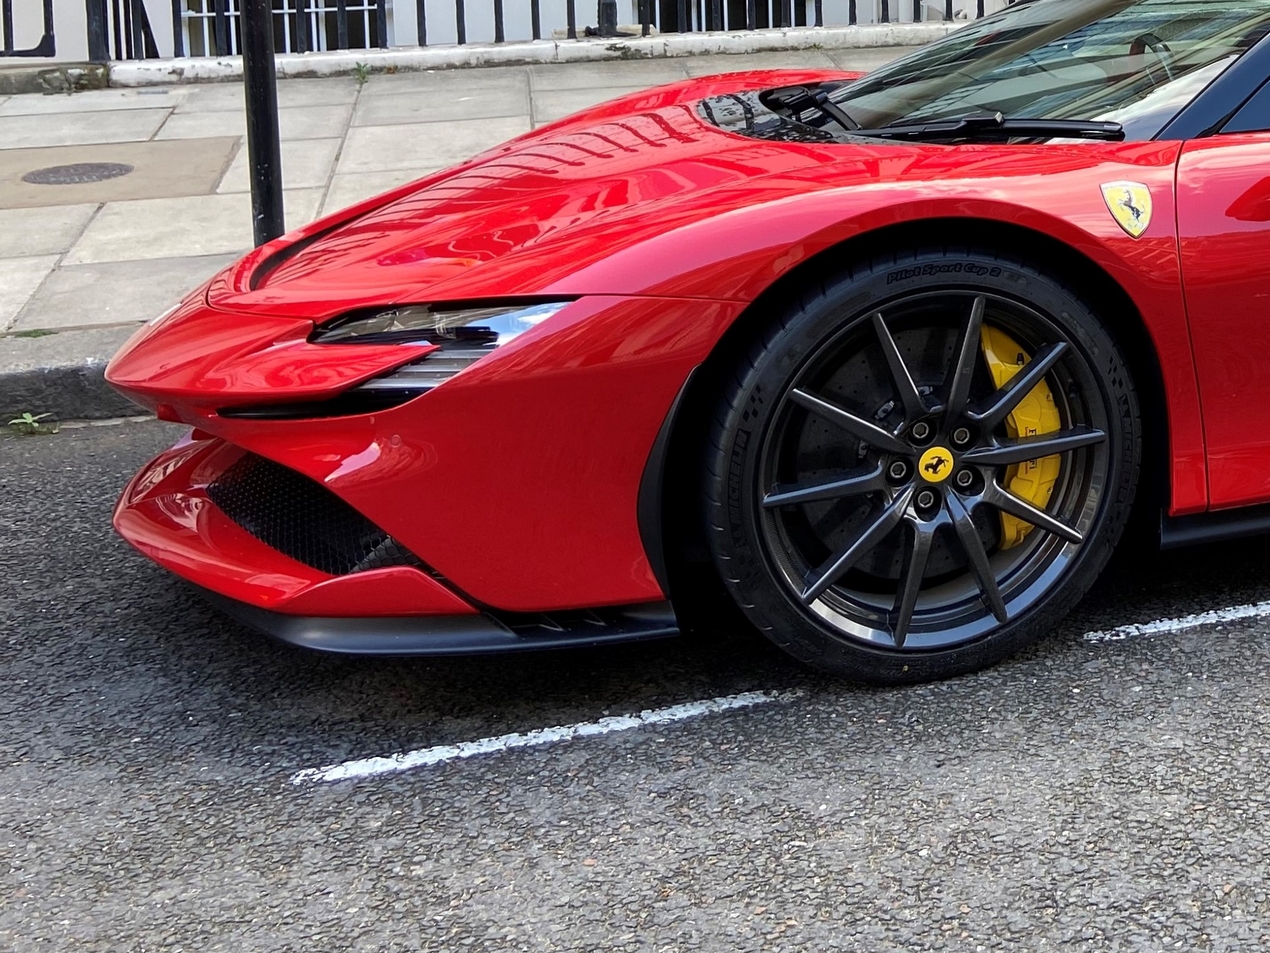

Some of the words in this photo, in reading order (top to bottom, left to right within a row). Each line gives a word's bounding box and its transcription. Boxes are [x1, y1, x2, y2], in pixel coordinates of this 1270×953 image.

[922, 262, 963, 276] Sport
[963, 263, 989, 276] Cup
[989, 267, 1002, 277] 2
[728, 429, 749, 525] MICHELIN
